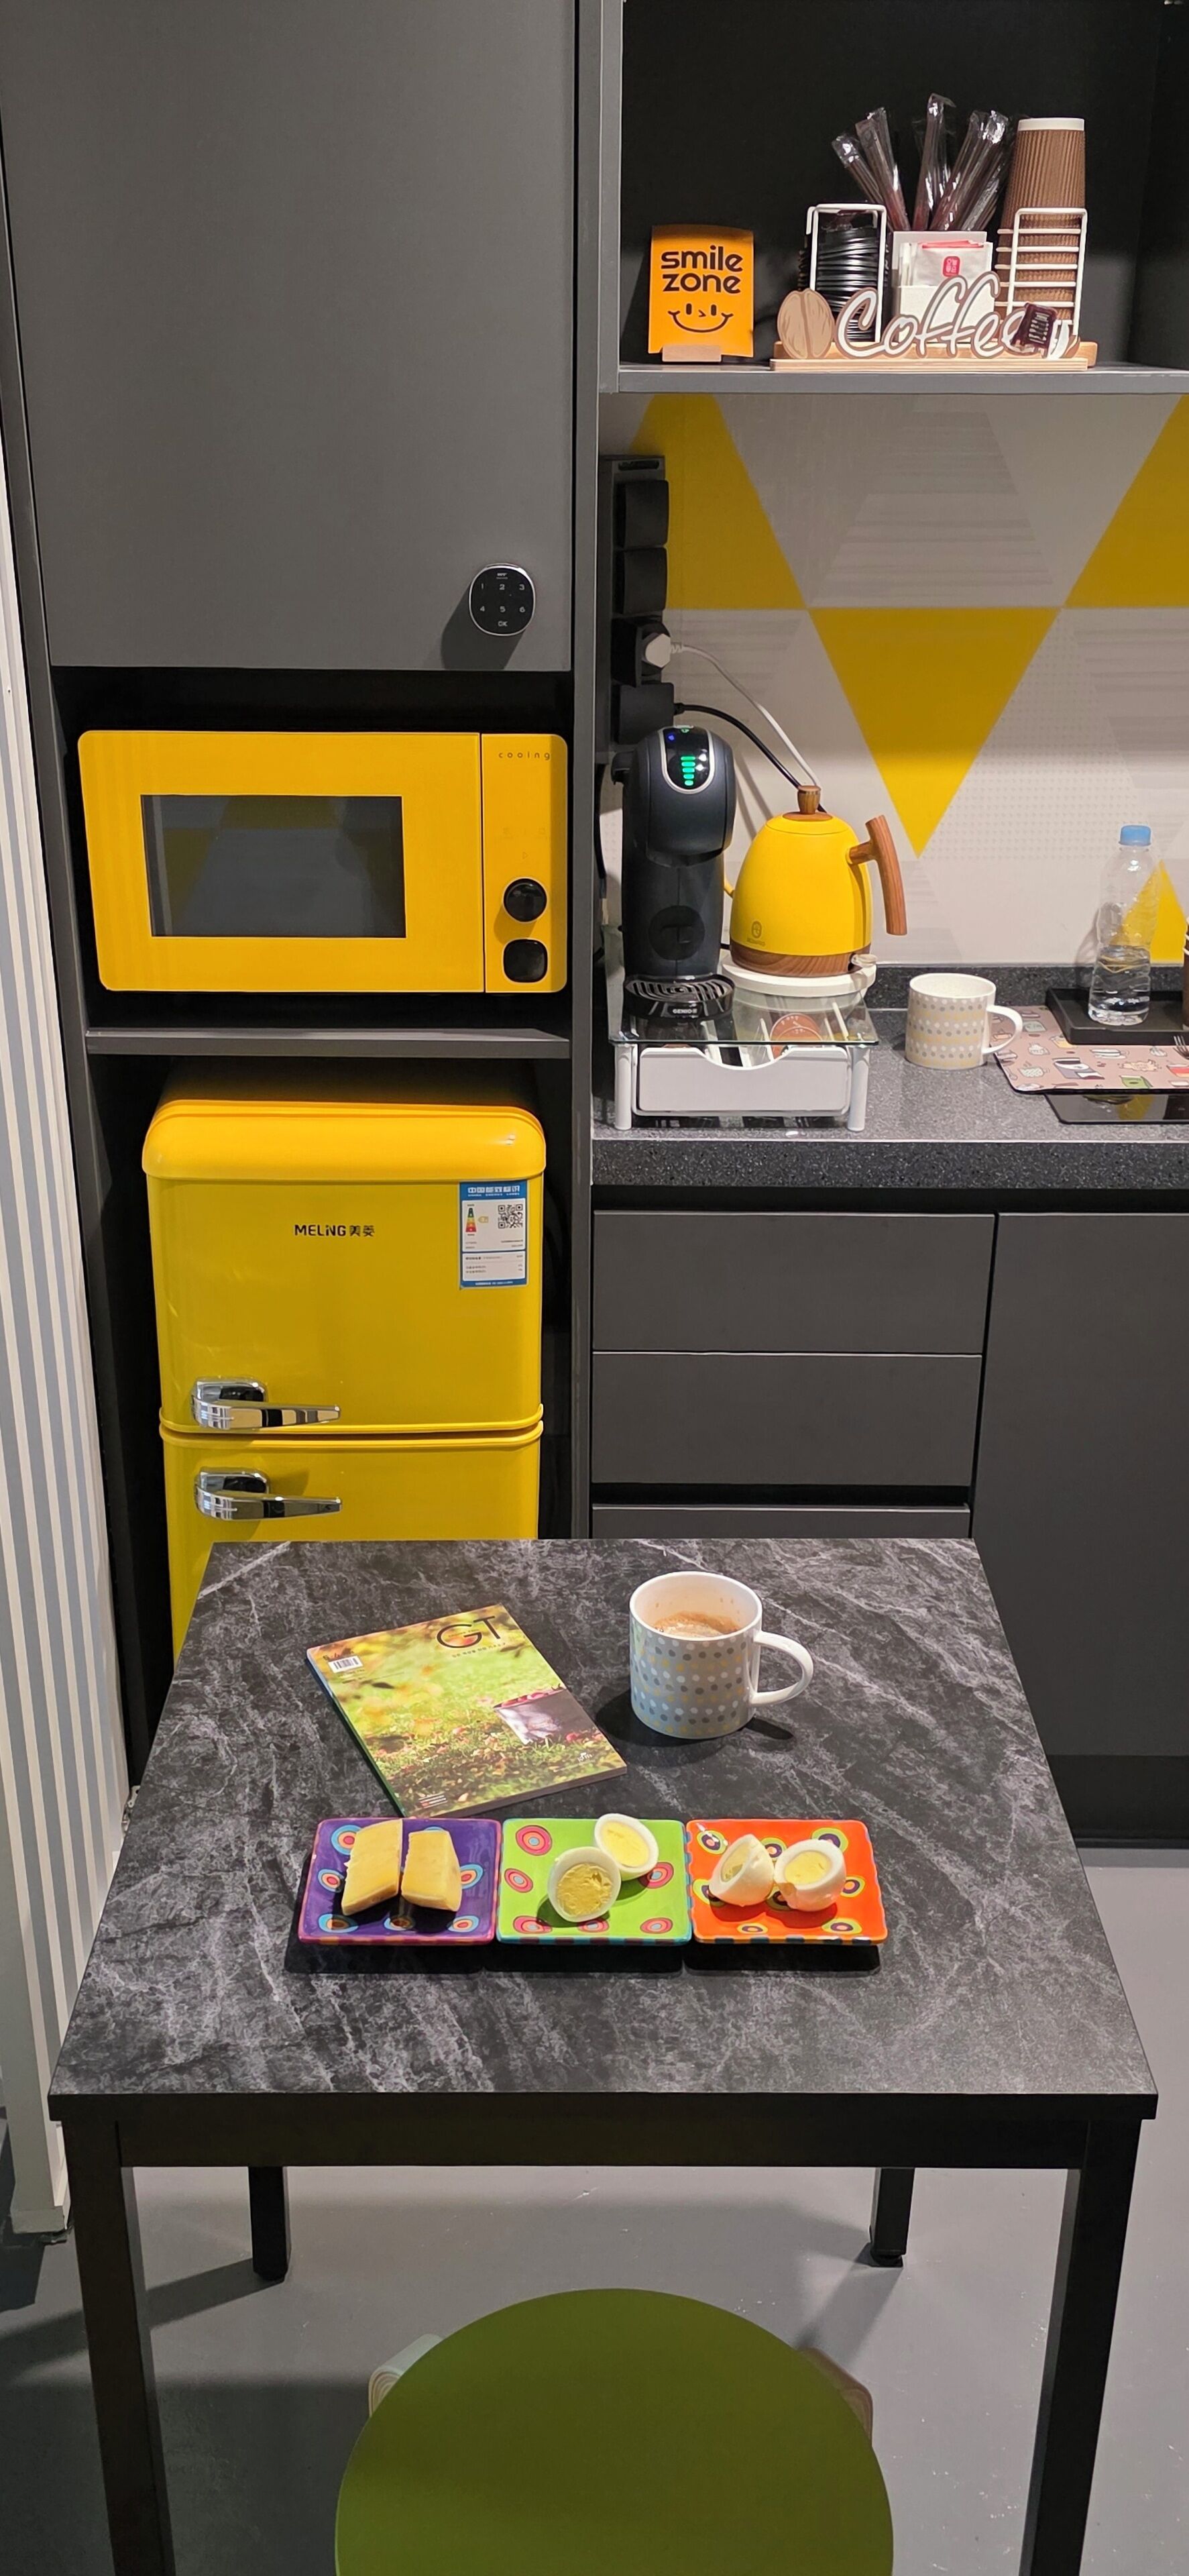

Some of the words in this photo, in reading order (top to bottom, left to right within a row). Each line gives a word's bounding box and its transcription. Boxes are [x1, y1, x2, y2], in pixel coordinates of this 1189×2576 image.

[661, 244, 743, 272] smile
[662, 272, 741, 294] zone
[437, 1615, 501, 1648] GT
